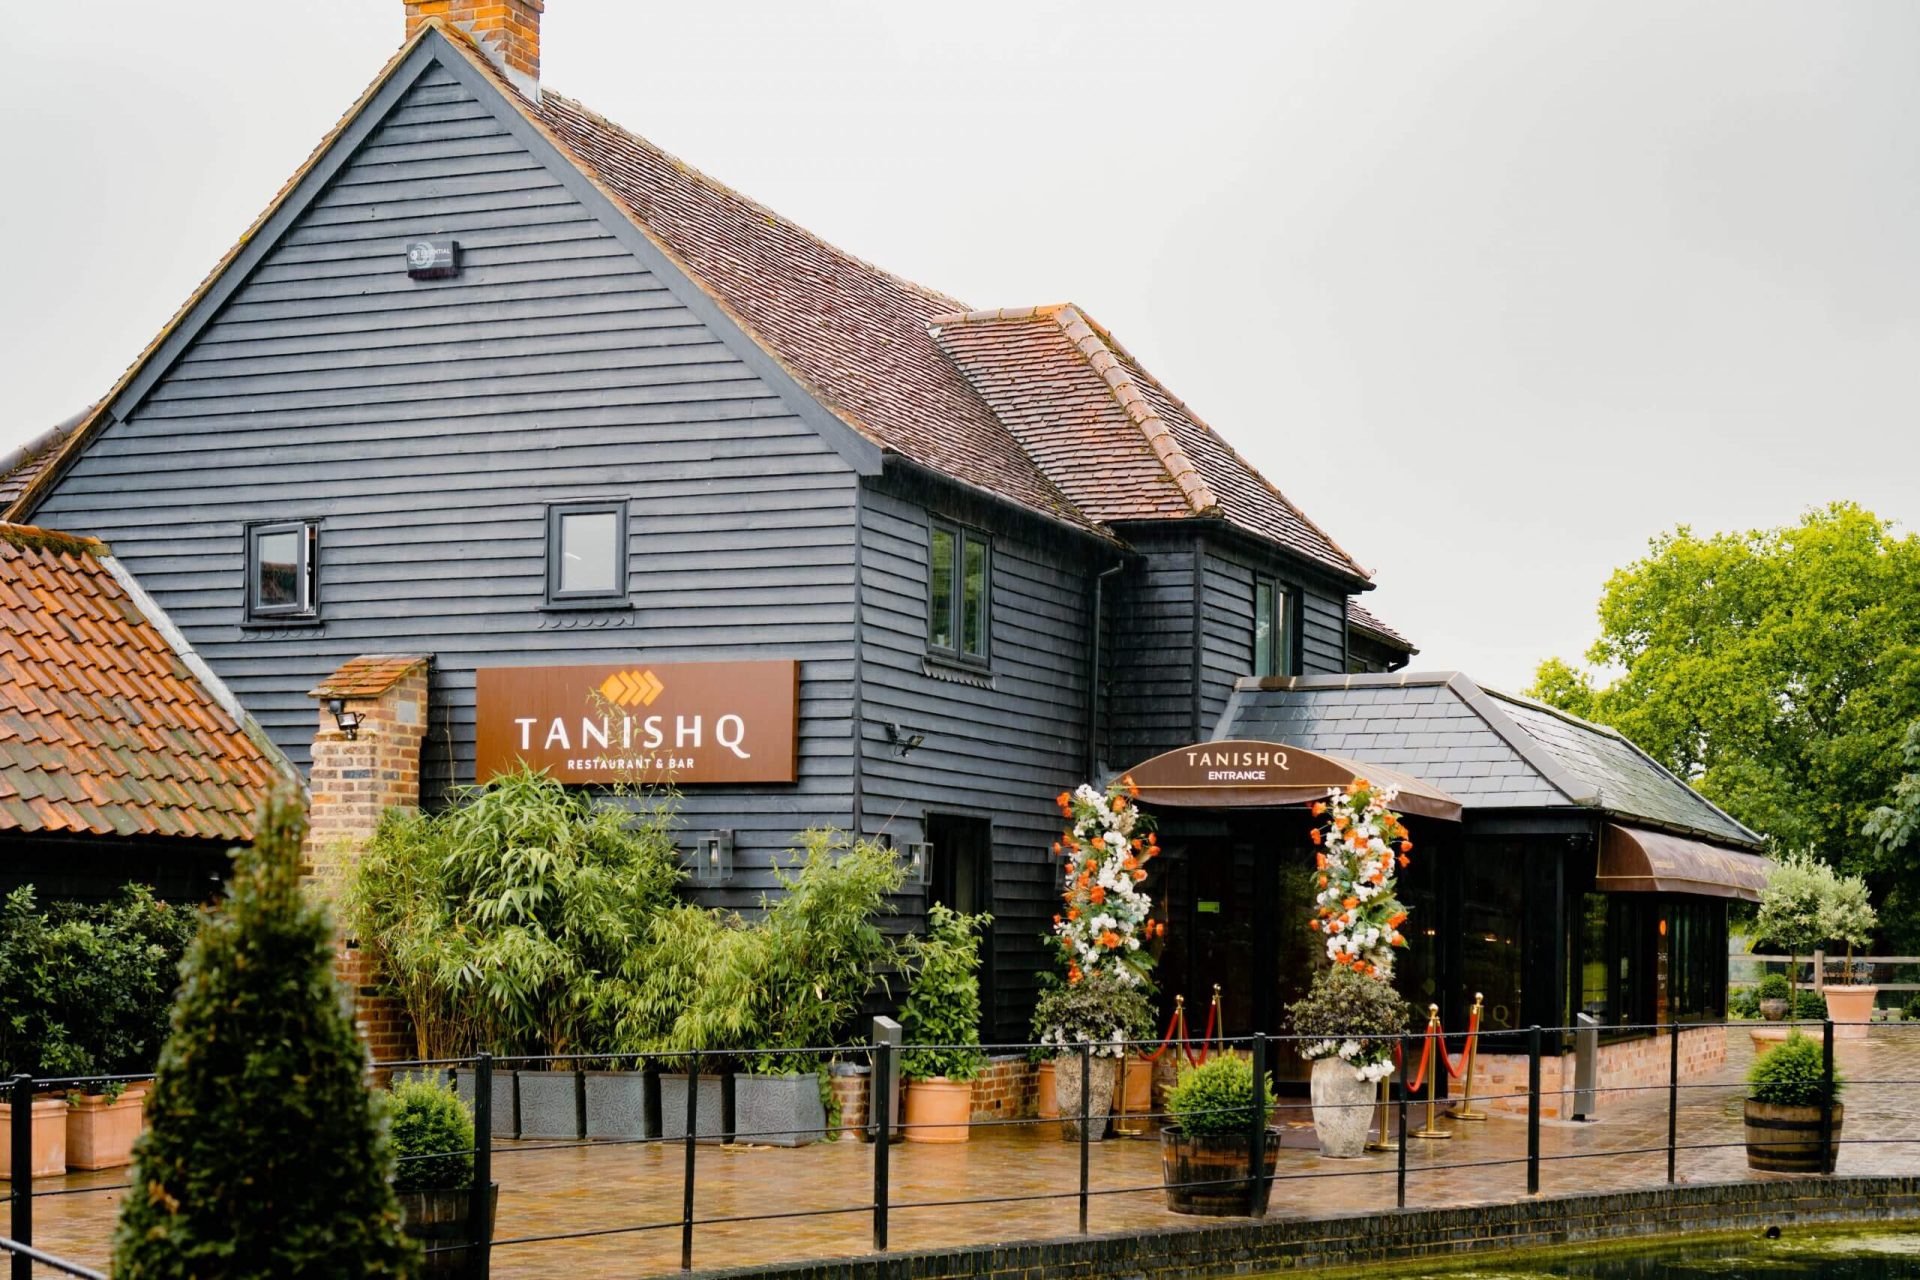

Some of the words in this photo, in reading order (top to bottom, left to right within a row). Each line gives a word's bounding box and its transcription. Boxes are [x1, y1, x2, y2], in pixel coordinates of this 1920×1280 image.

[514, 713, 751, 759] TANISHQ
[568, 758, 651, 770] RESTAURANT
[656, 759, 664, 769] &
[669, 758, 694, 769] BAR
[1187, 752, 1289, 770] TANISHQ
[1208, 771, 1265, 781] ENTRANCE
